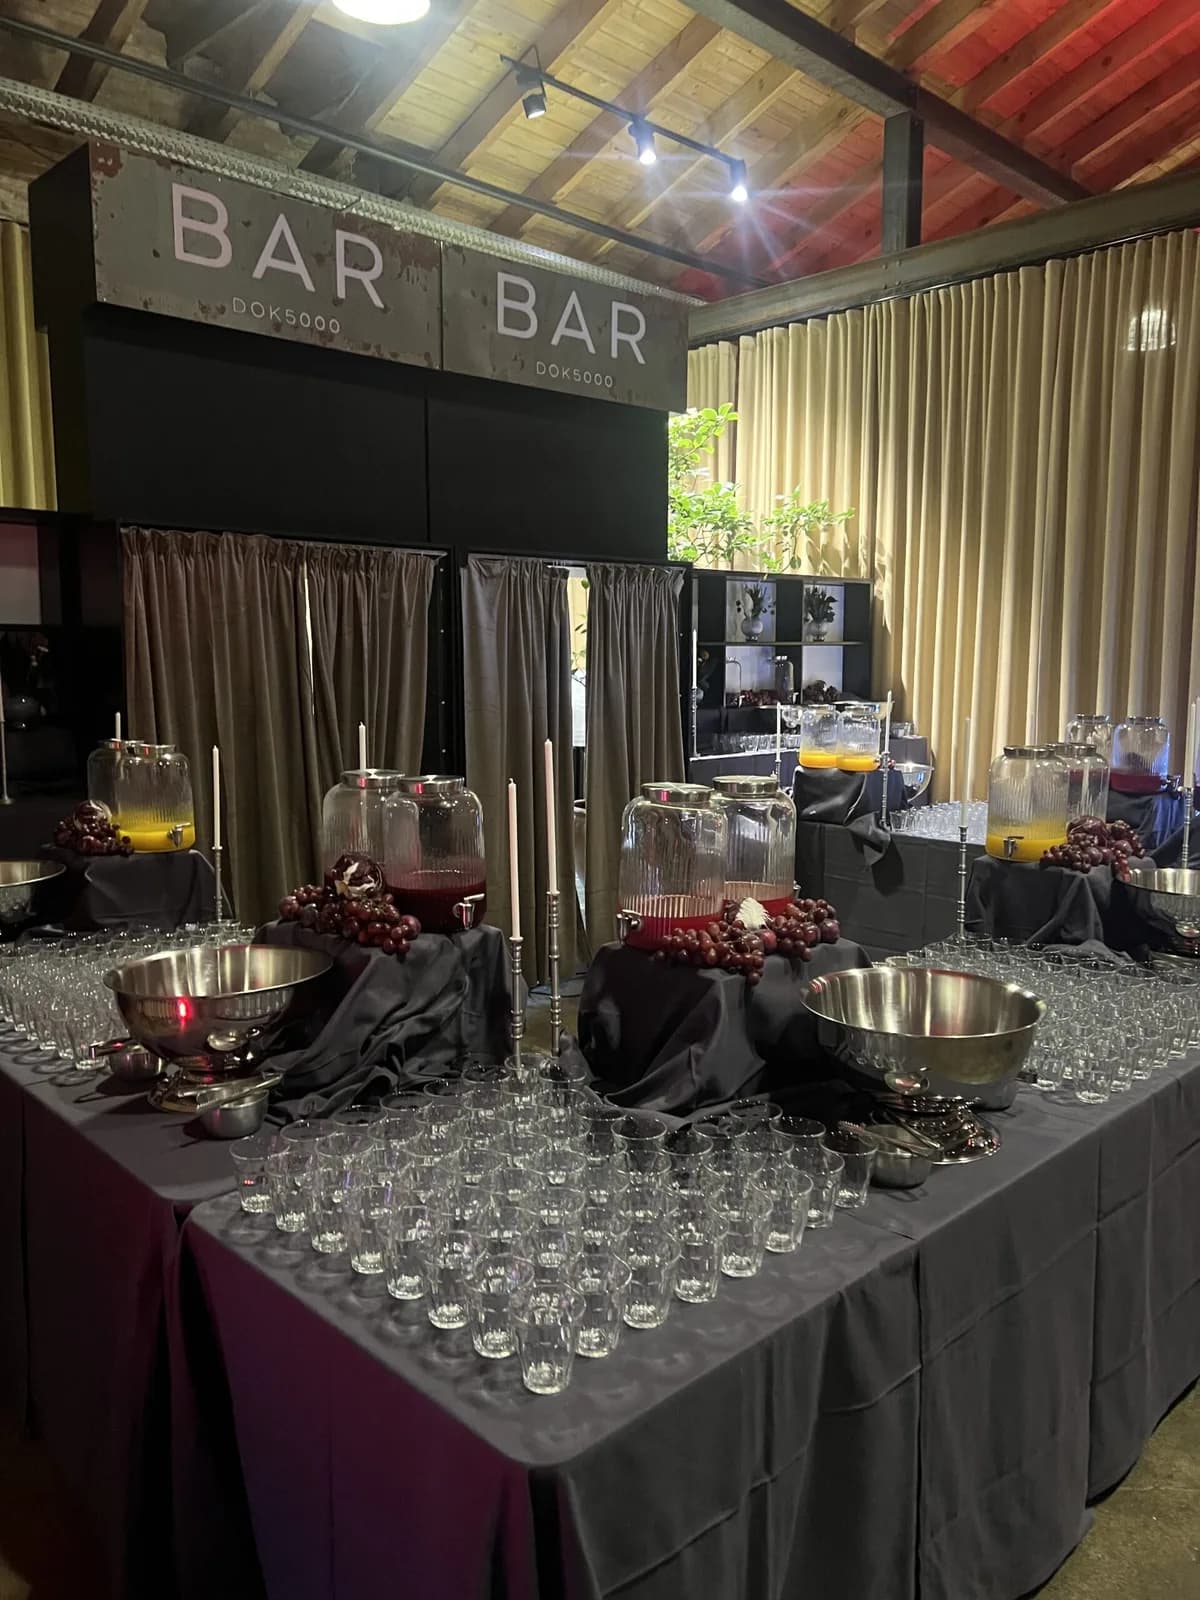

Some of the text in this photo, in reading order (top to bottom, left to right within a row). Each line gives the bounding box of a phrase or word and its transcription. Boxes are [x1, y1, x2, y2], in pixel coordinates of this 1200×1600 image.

[171, 183, 385, 308] BAR
[232, 298, 341, 334] DOK5000
[497, 272, 646, 364] BAR
[536, 361, 614, 388] DOK5000
